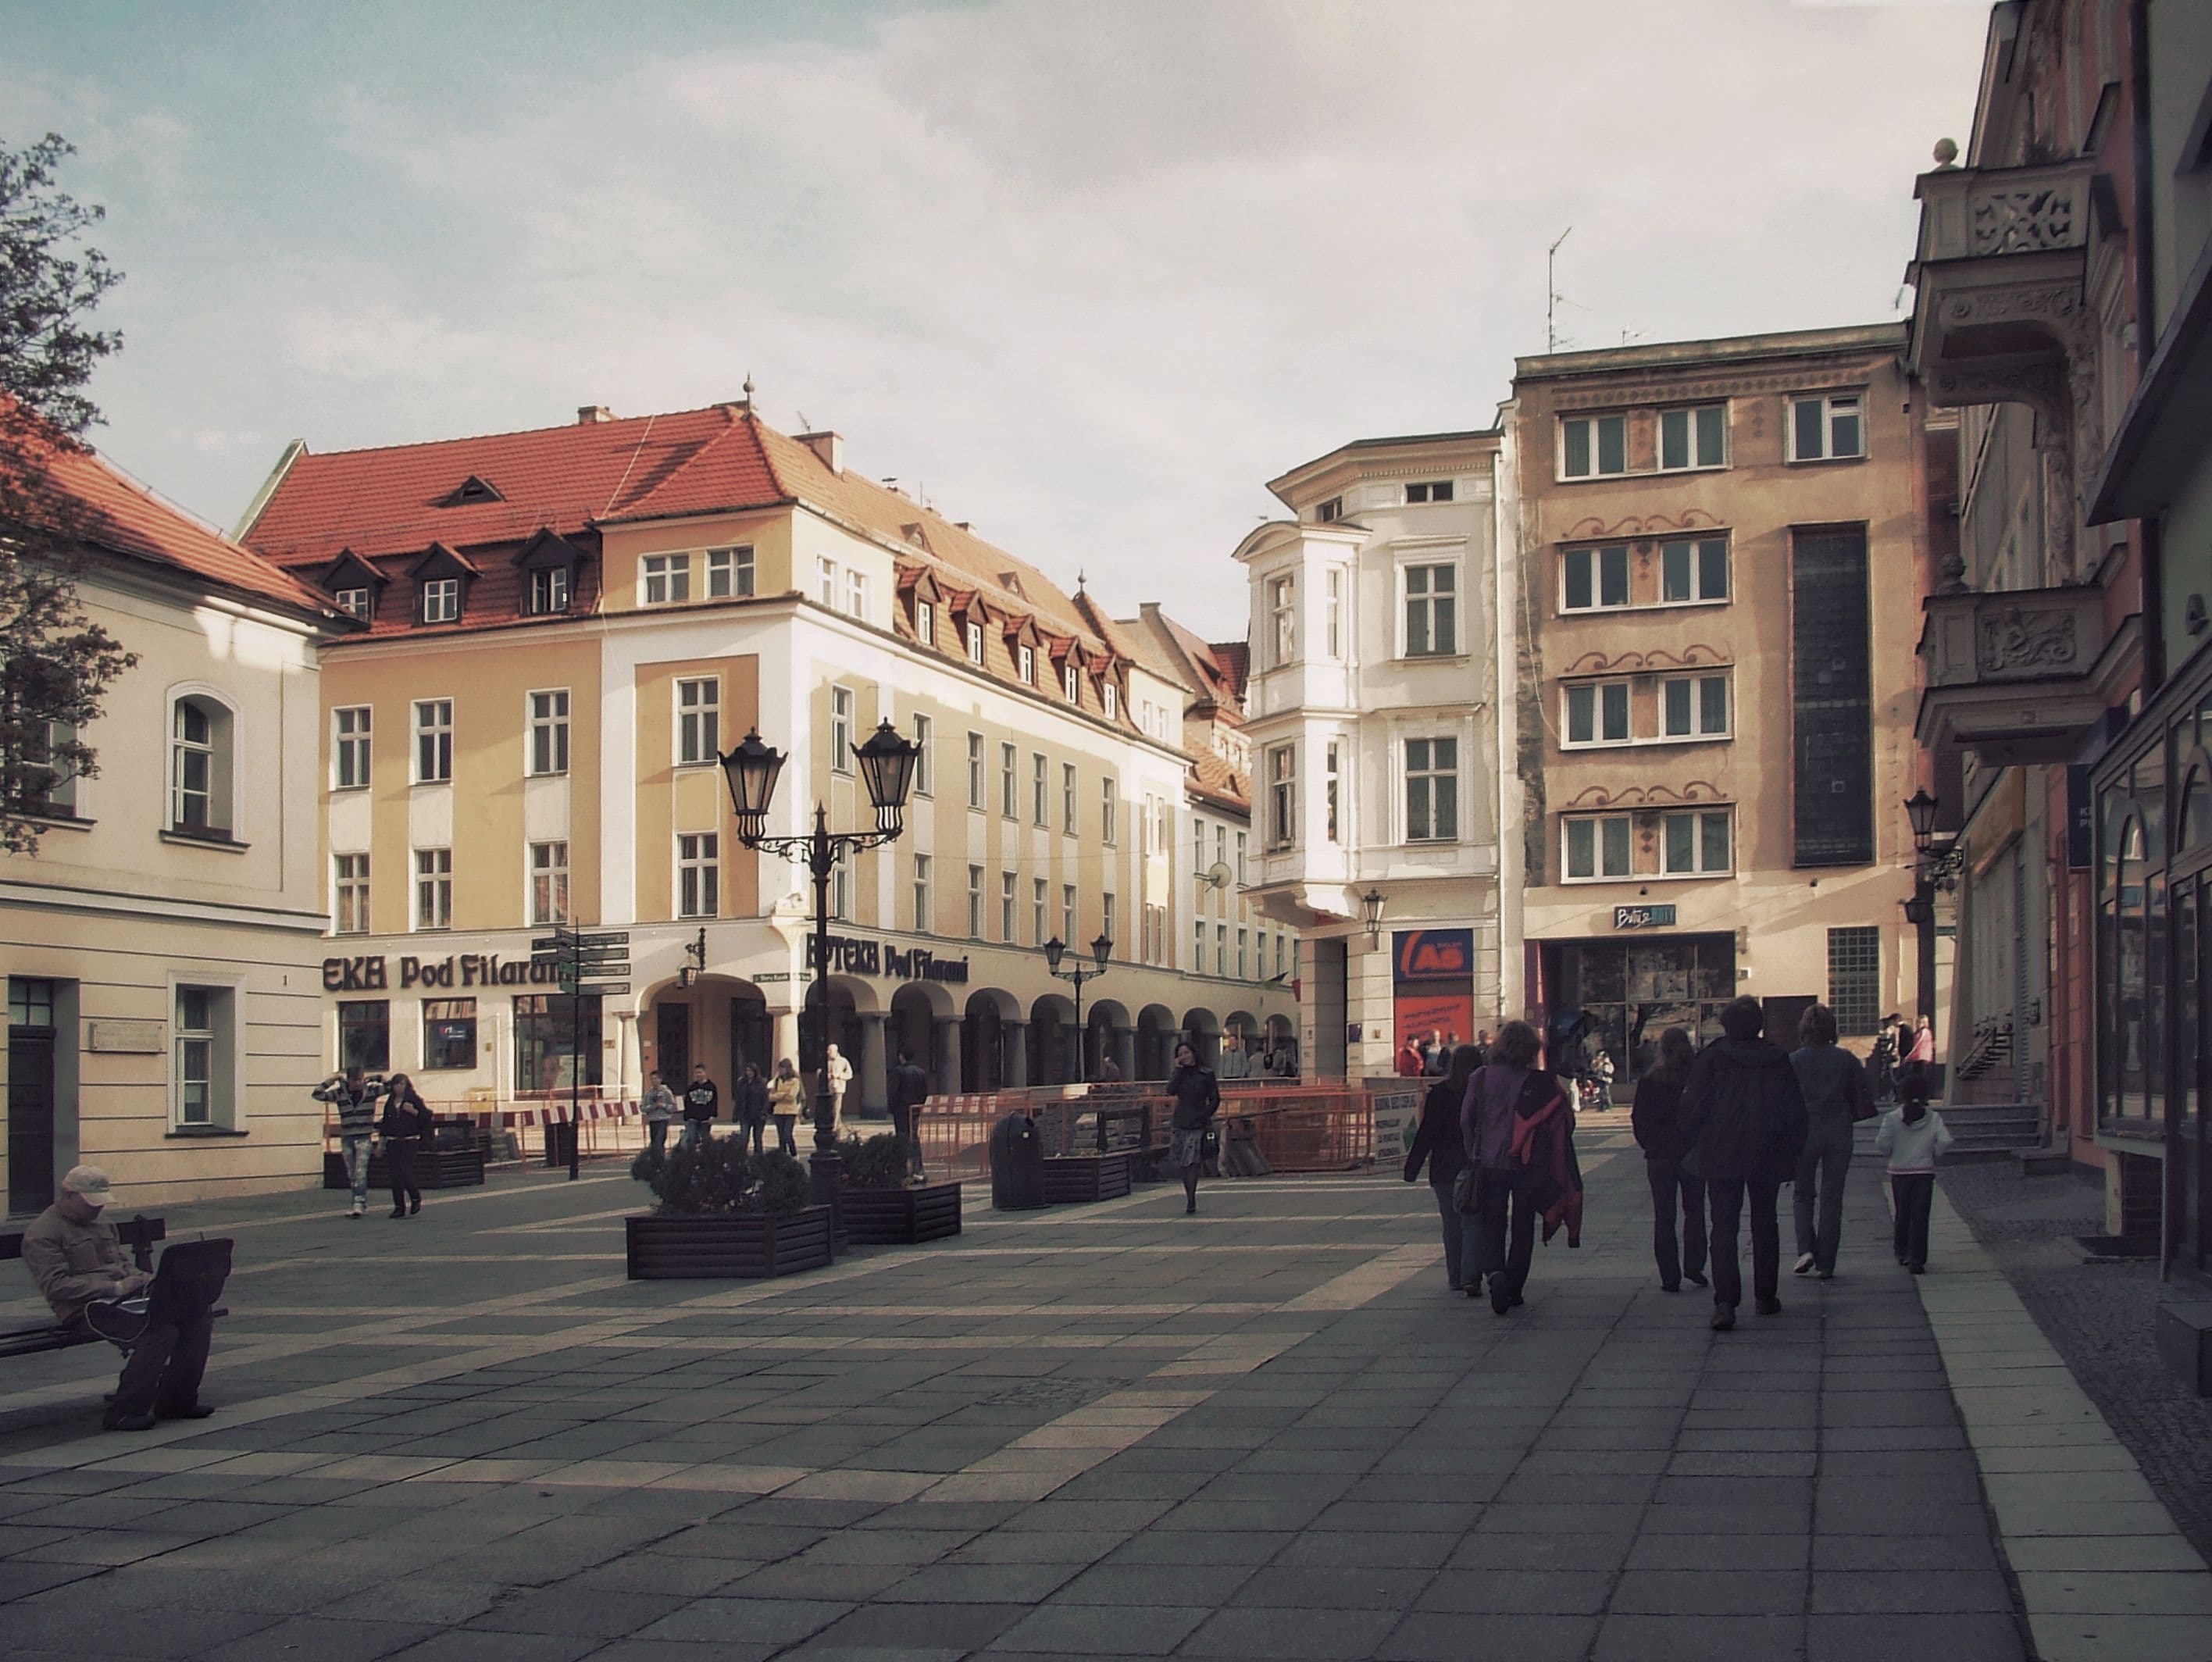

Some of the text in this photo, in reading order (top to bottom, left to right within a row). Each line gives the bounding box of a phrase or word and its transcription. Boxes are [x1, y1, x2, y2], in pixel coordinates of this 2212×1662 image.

[401, 956, 454, 988] Pod
[461, 954, 575, 986] Filara
[885, 945, 912, 977] Pod
